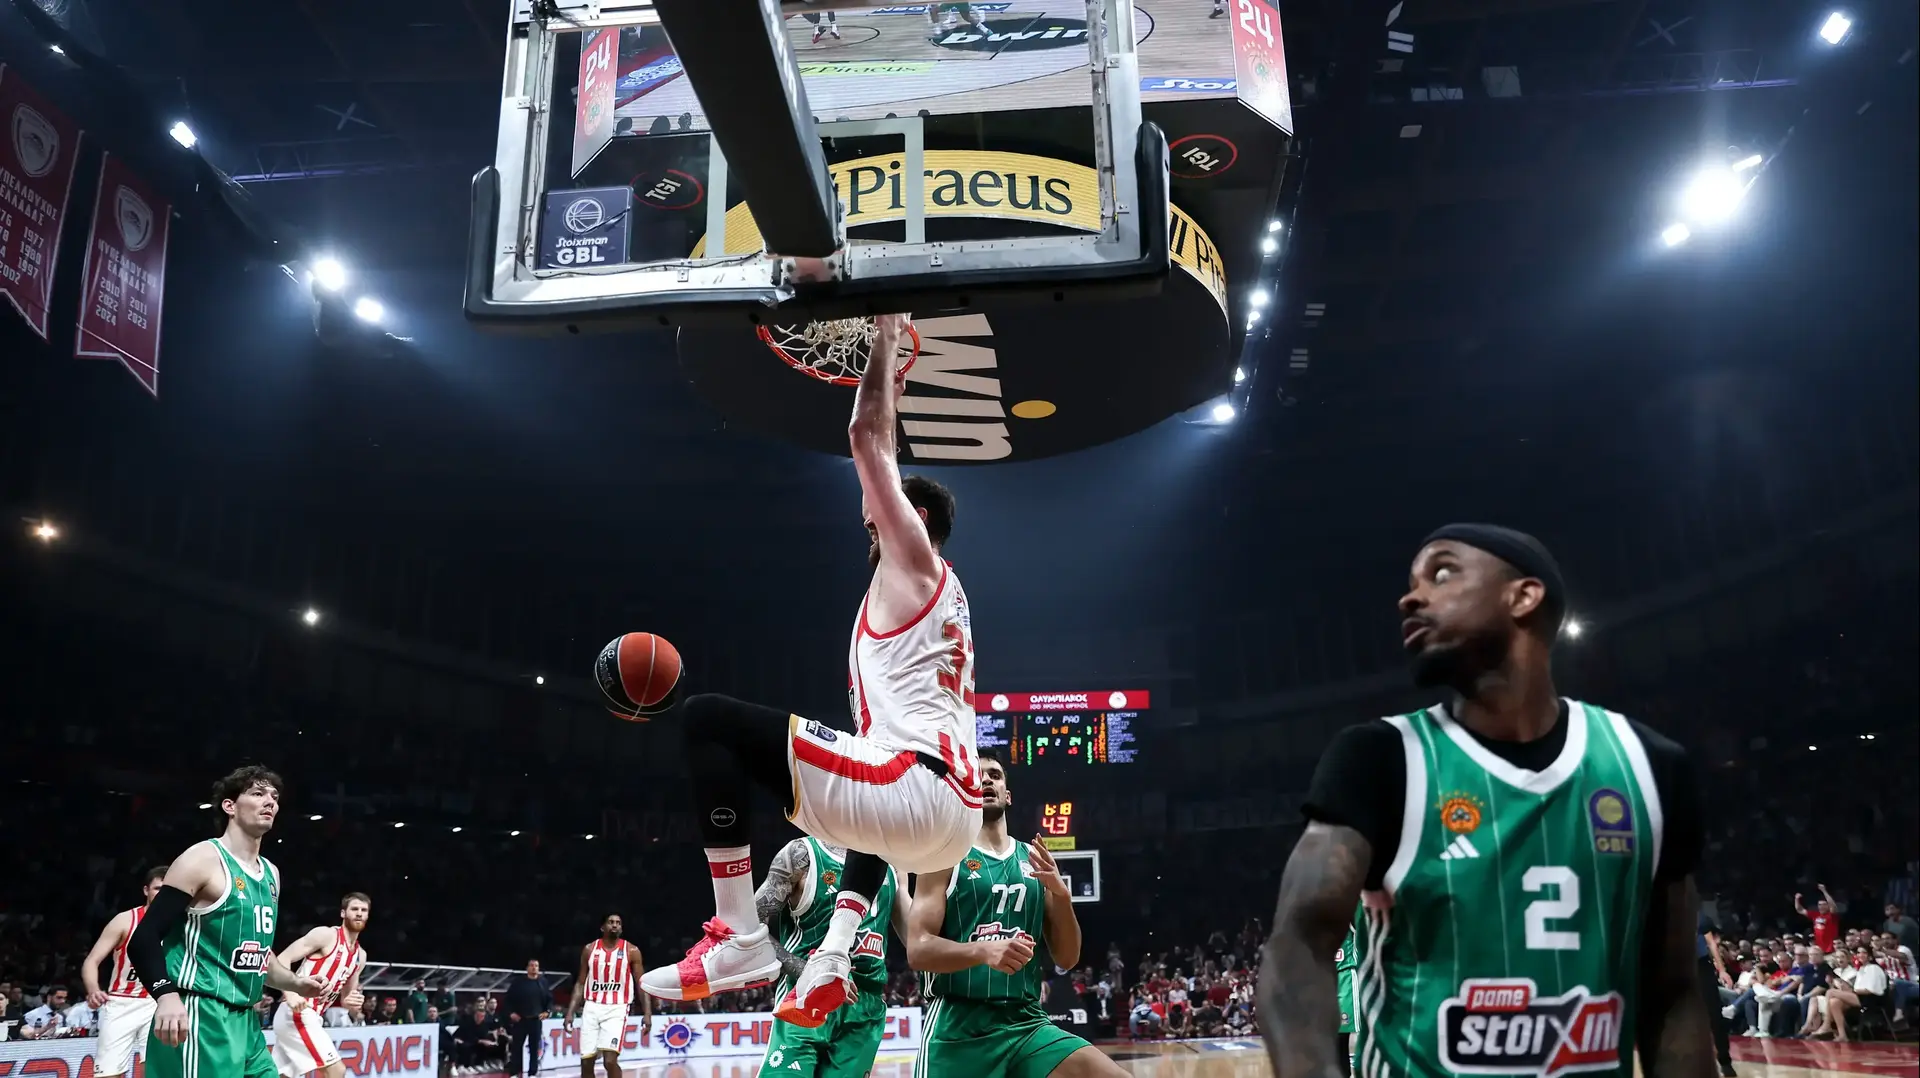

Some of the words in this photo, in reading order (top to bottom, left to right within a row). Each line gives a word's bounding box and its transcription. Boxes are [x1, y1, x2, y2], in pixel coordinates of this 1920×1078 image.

[940, 27, 1089, 44] bwin
[1239, 0, 1274, 48] 24
[584, 34, 610, 92] 24
[1181, 146, 1220, 172] TGI
[645, 177, 682, 201] TGI
[0, 207, 13, 228] 76
[24, 226, 45, 249] 1977
[555, 236, 609, 249] Stoiximan
[18, 256, 39, 279] 1997
[556, 246, 605, 265] GBL
[100, 276, 121, 298] 2010
[129, 296, 148, 316] 2011
[96, 304, 117, 327] 2024
[98, 290, 119, 313] 2022
[127, 309, 147, 330] 2023
[1035, 716, 1053, 724] OLY
[1062, 715, 1080, 724] PAO
[1596, 836, 1630, 849] GBL
[991, 883, 1027, 914] 77
[1522, 865, 1580, 950] 2
[253, 904, 274, 935] 16
[591, 979, 621, 992] bwin
[1471, 988, 1525, 1009] pame
